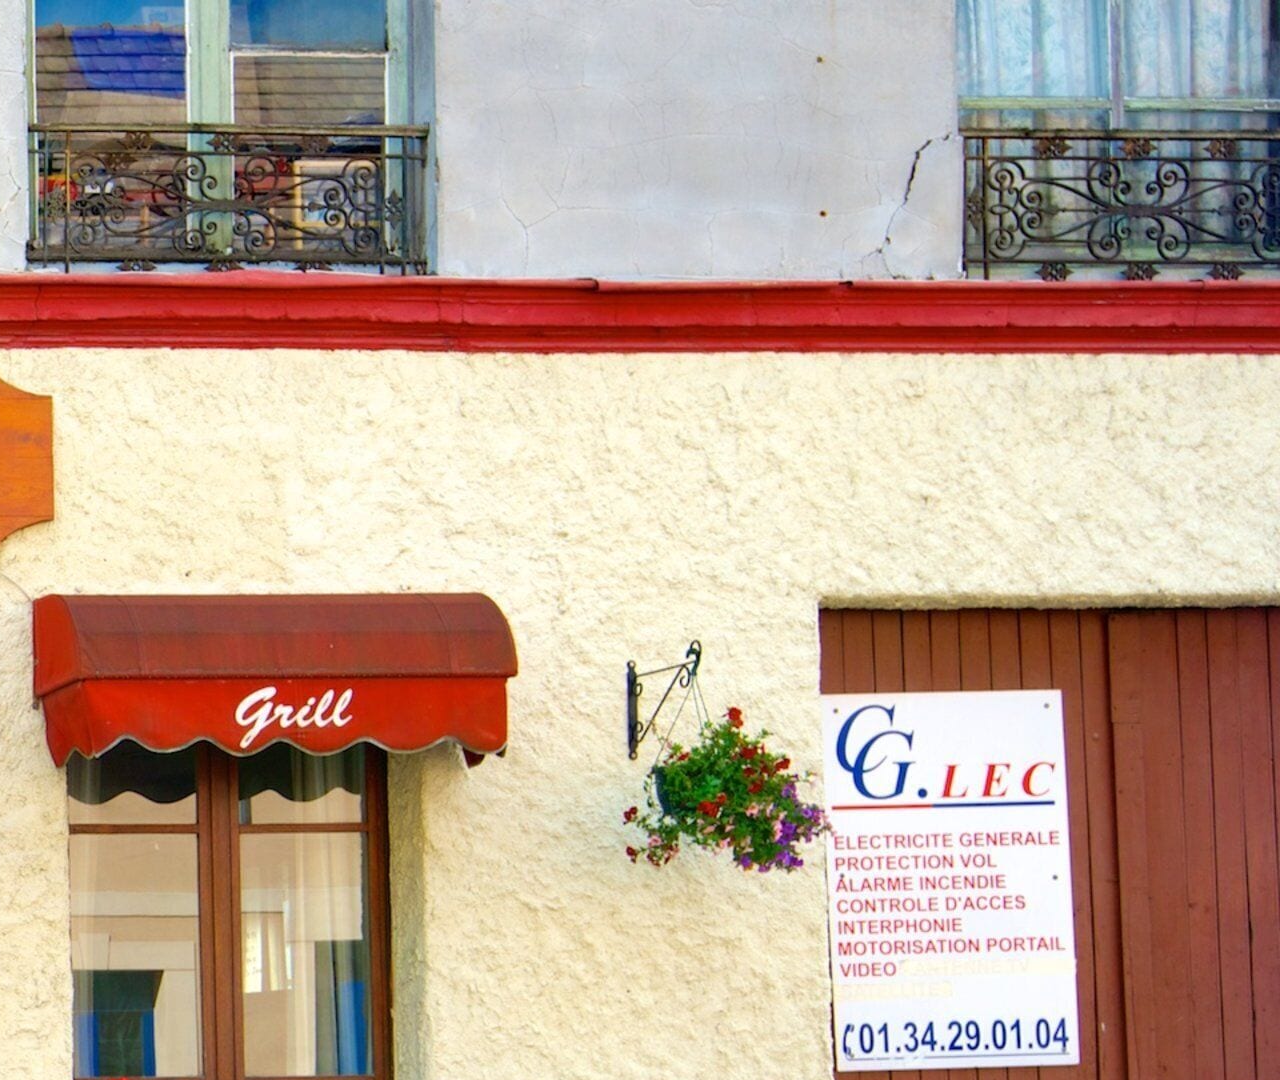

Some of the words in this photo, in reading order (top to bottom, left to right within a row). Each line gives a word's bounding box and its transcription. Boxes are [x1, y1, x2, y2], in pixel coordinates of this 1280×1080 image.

[234, 685, 353, 749] Grill
[834, 834, 953, 850] ELECTRICITE
[959, 830, 1060, 847] GENERALE
[835, 855, 954, 871] PROTECTION
[960, 853, 997, 868] VOL
[836, 876, 914, 892] ALARME
[920, 874, 1007, 890] INCENDIE
[837, 897, 939, 914] CONTROLE
[945, 895, 1026, 911] D'ACCES
[838, 918, 962, 935] INTERPHONIE
[838, 939, 980, 956] MOTORISATION
[986, 937, 1066, 952] PORTAIL
[840, 962, 897, 978] VIDEO
[859, 1017, 1069, 1054] 01.34.29.01.04
